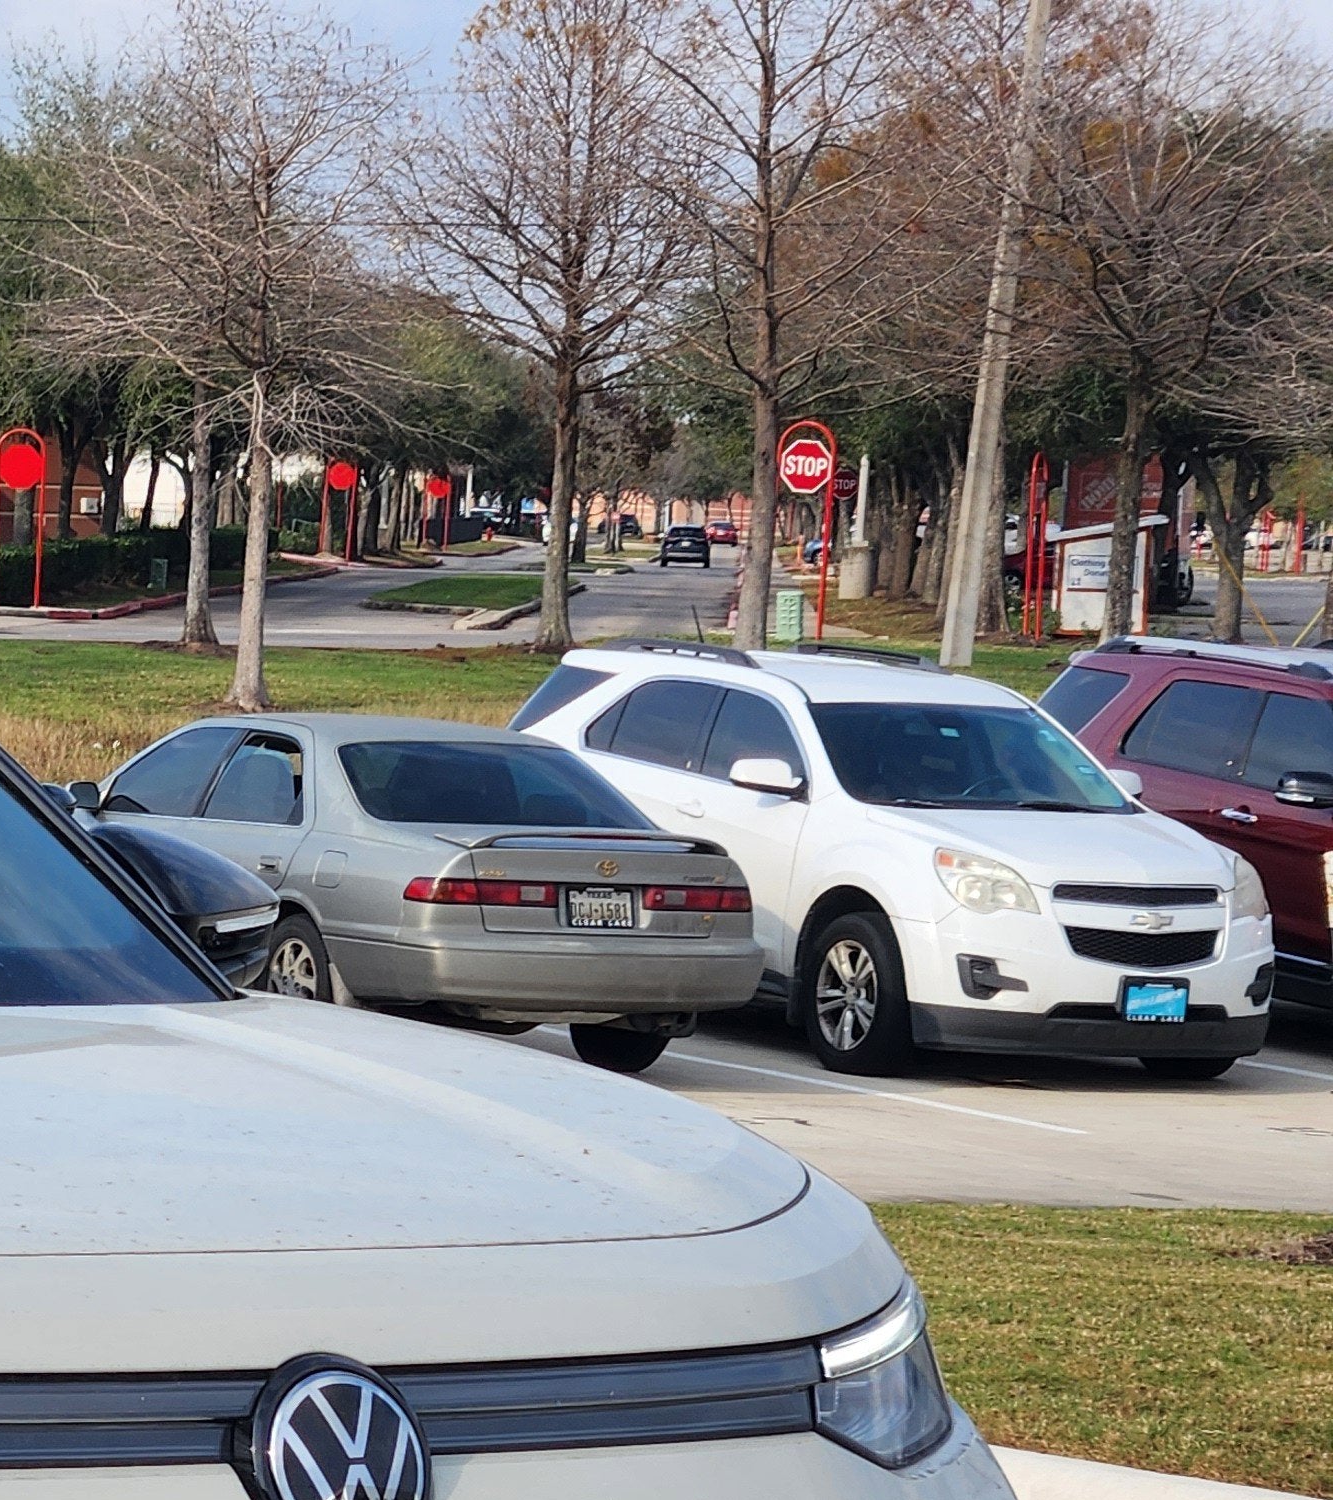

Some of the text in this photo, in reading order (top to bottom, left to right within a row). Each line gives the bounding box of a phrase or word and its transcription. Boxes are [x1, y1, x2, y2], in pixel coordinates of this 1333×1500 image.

[784, 454, 829, 477] STOP
[833, 479, 857, 490] STOP
[1070, 558, 1107, 568] Clothing
